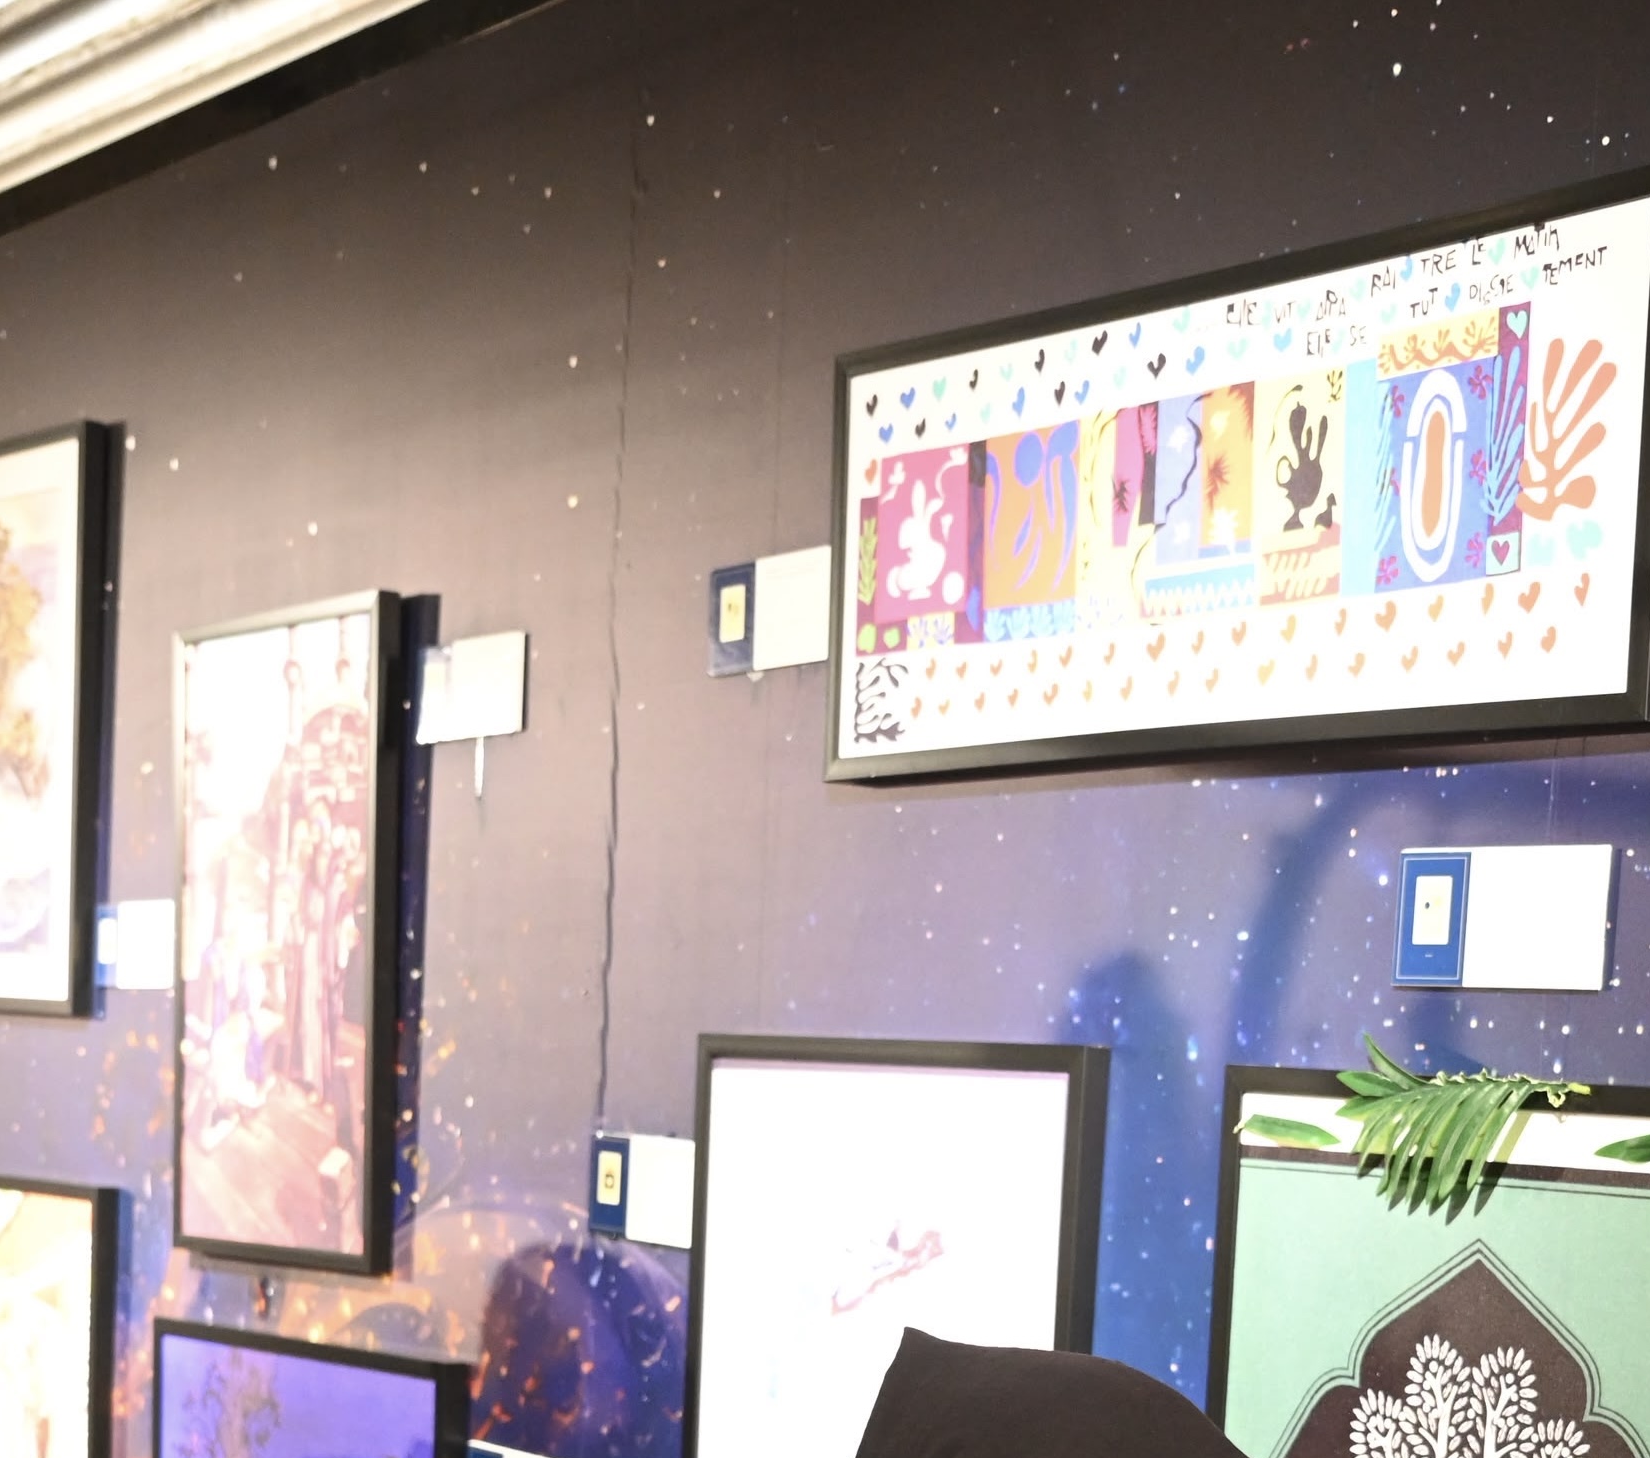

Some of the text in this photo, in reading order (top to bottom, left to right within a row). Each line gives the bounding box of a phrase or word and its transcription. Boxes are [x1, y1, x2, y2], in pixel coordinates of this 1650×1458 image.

[1410, 287, 1439, 318] TUT
[1543, 246, 1608, 285] TEMENT
[1420, 249, 1457, 276] TRE
